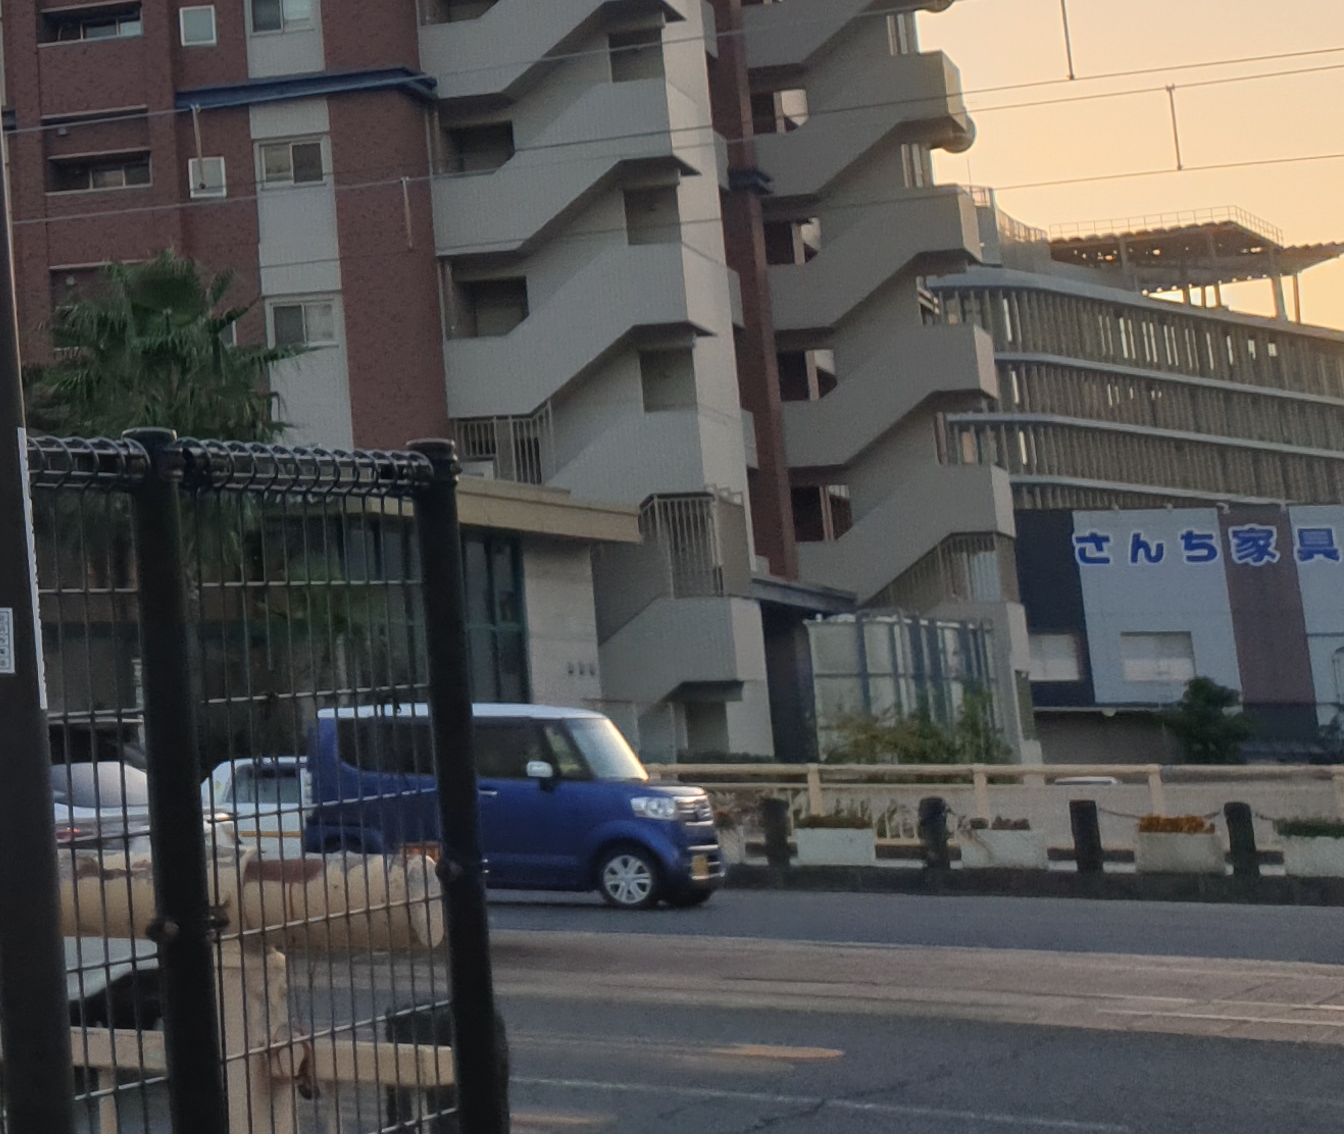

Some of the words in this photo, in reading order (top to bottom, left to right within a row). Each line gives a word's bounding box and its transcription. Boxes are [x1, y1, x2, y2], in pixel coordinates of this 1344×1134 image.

[1074, 524, 1341, 567] さんち家具
